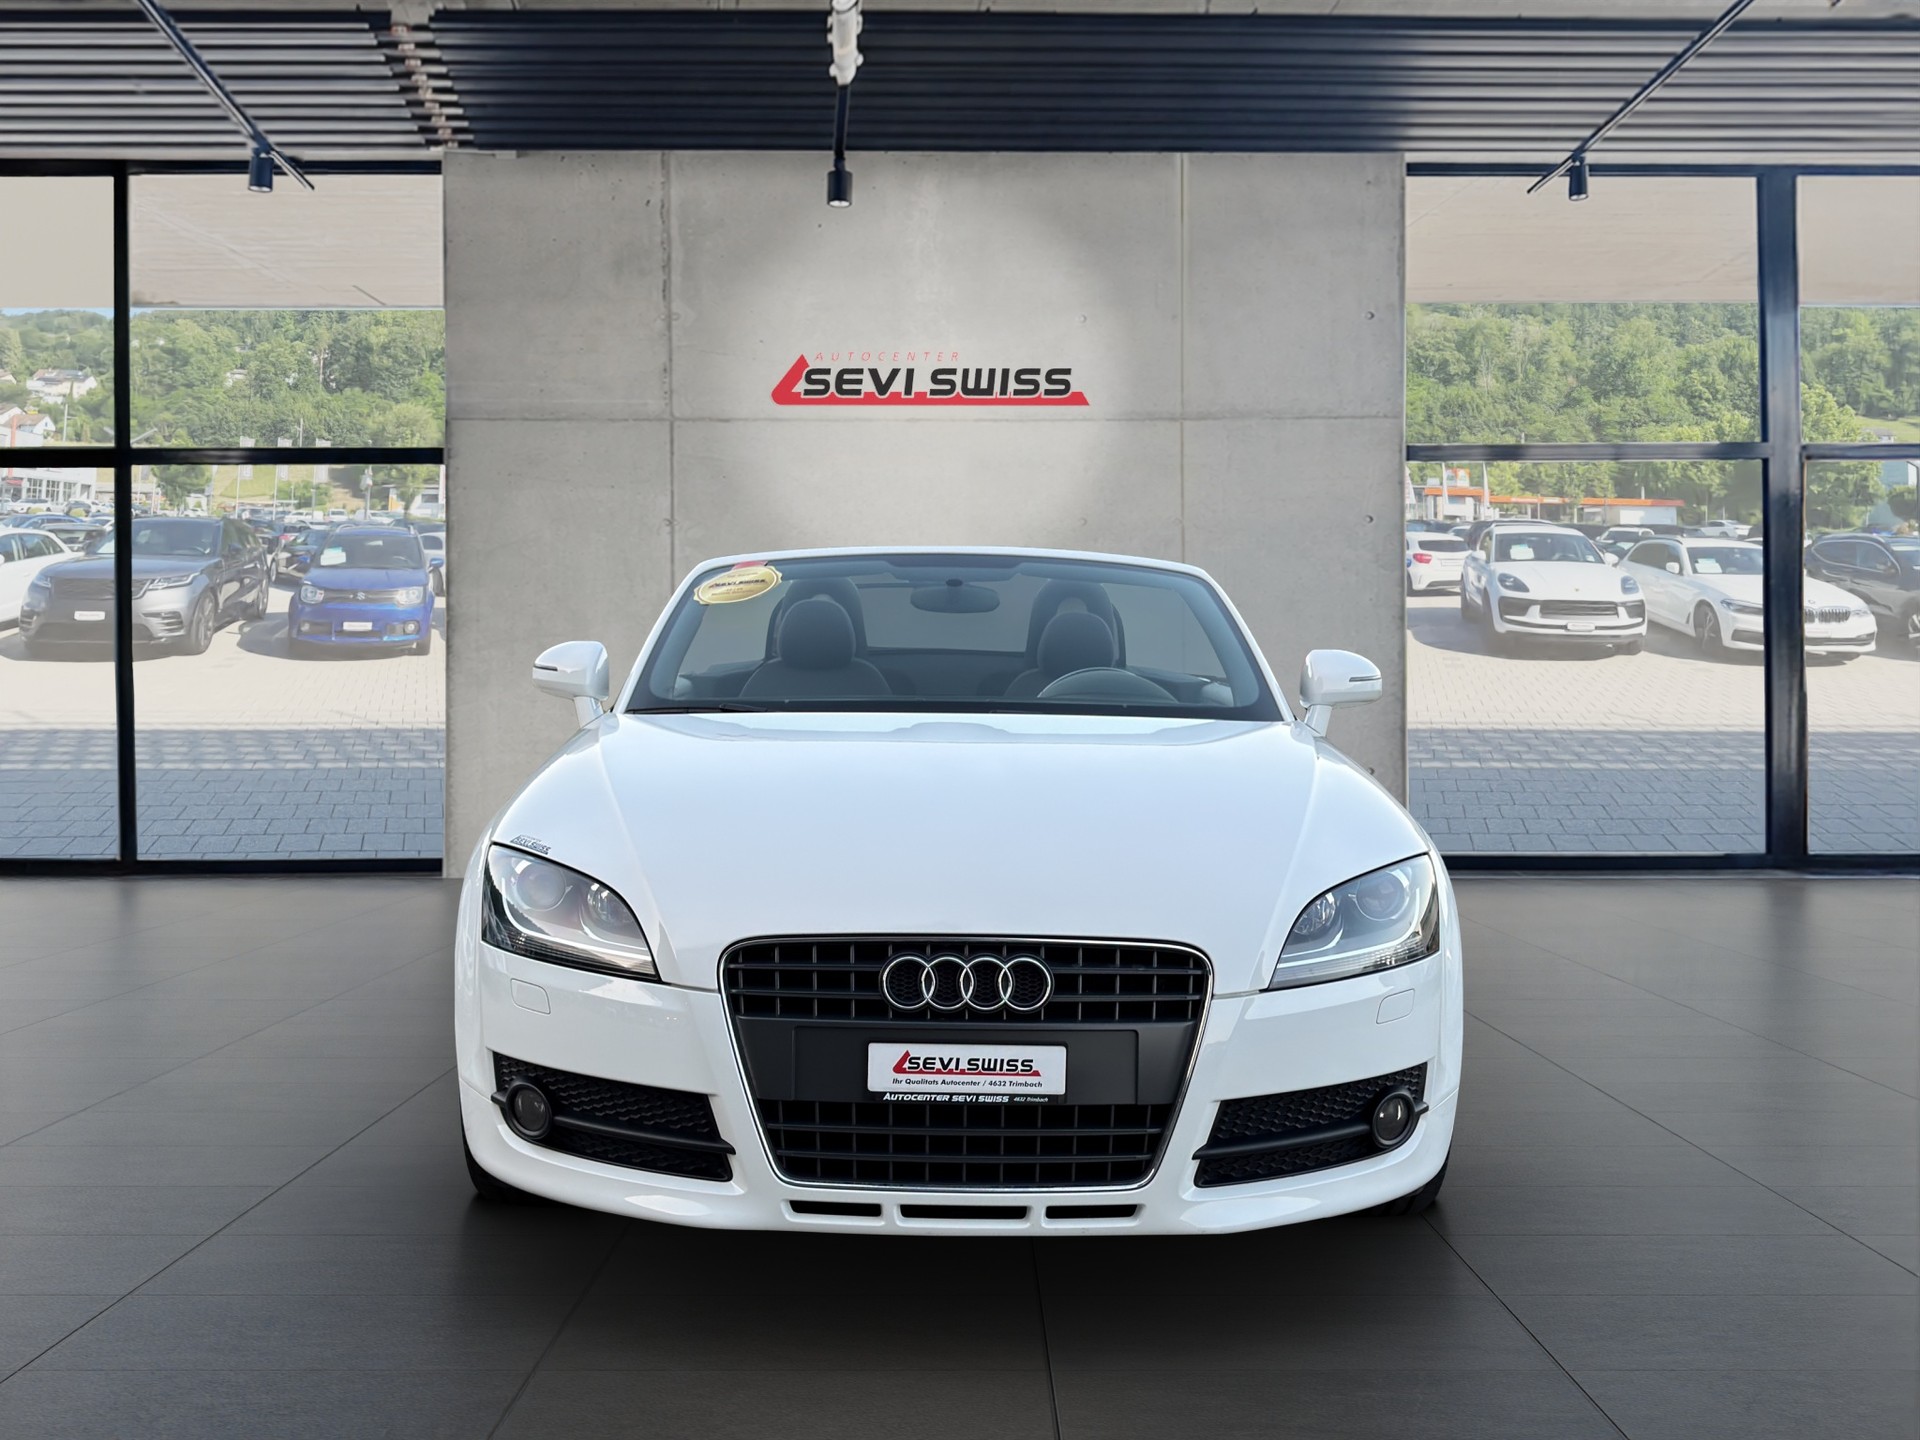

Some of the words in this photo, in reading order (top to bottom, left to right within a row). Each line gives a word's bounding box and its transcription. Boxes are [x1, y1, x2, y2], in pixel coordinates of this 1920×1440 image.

[814, 351, 960, 362] AUTOCENTER
[803, 367, 915, 396] SEVI
[929, 367, 1072, 396] SWISS
[907, 1056, 960, 1071] SEVI
[966, 1058, 1033, 1073] SWISS
[940, 1079, 980, 1087] Autocenter
[1008, 1080, 1043, 1088] Trimbach
[883, 1092, 950, 1102] AUTOCENTER
[951, 1094, 976, 1103] SEVI
[977, 1095, 1009, 1103] SWISS
